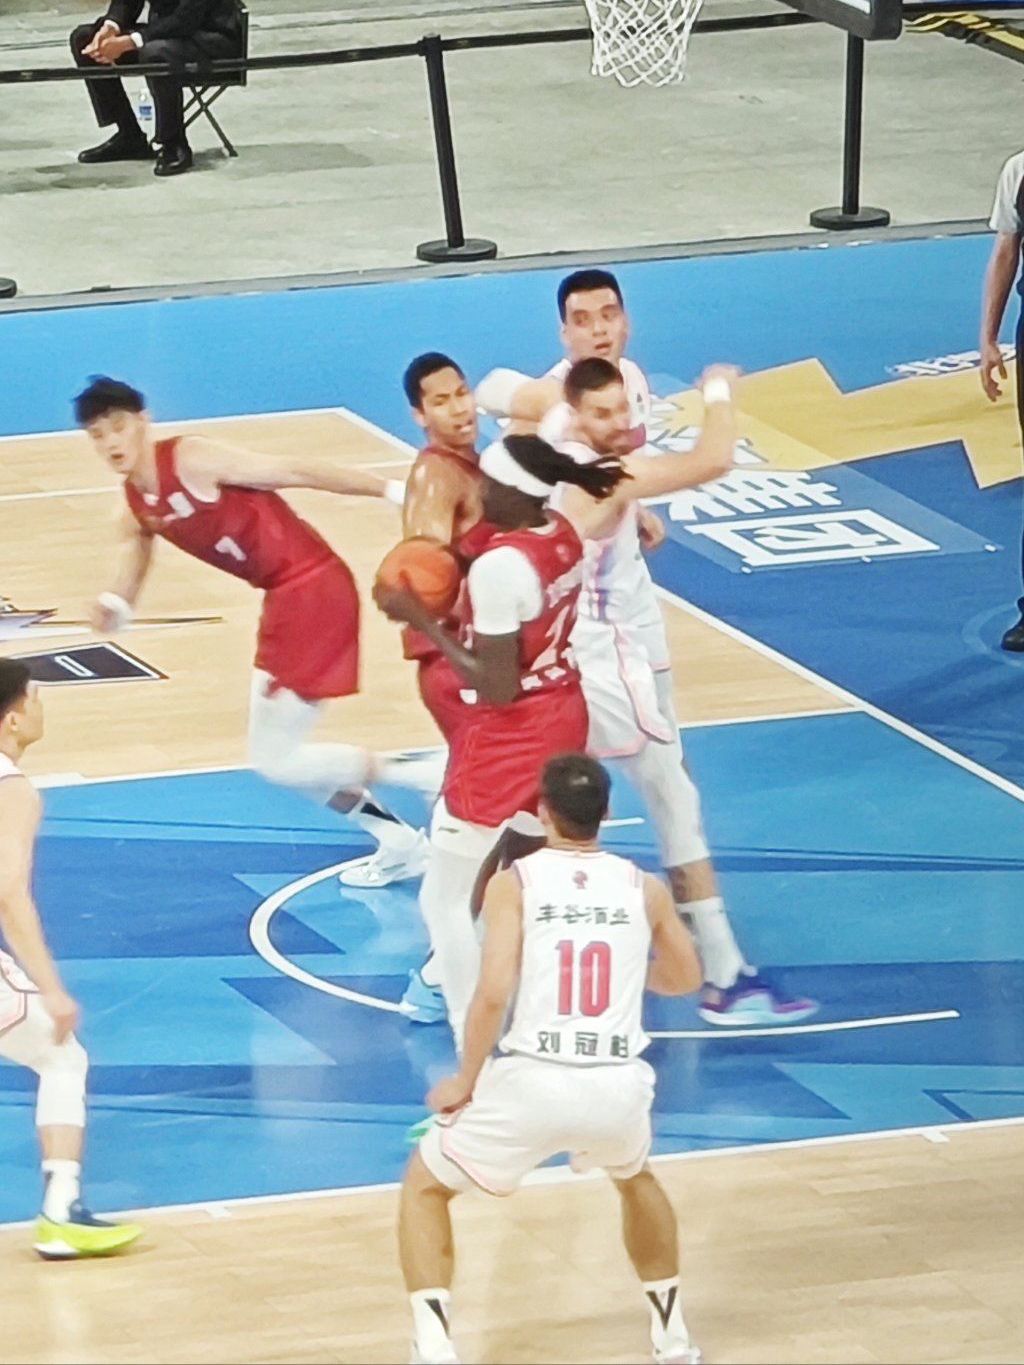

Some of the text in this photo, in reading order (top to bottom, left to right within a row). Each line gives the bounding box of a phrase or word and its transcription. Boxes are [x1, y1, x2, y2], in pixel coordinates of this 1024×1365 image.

[535, 903, 630, 926] 丰谷酒业
[555, 939, 611, 1017] 10
